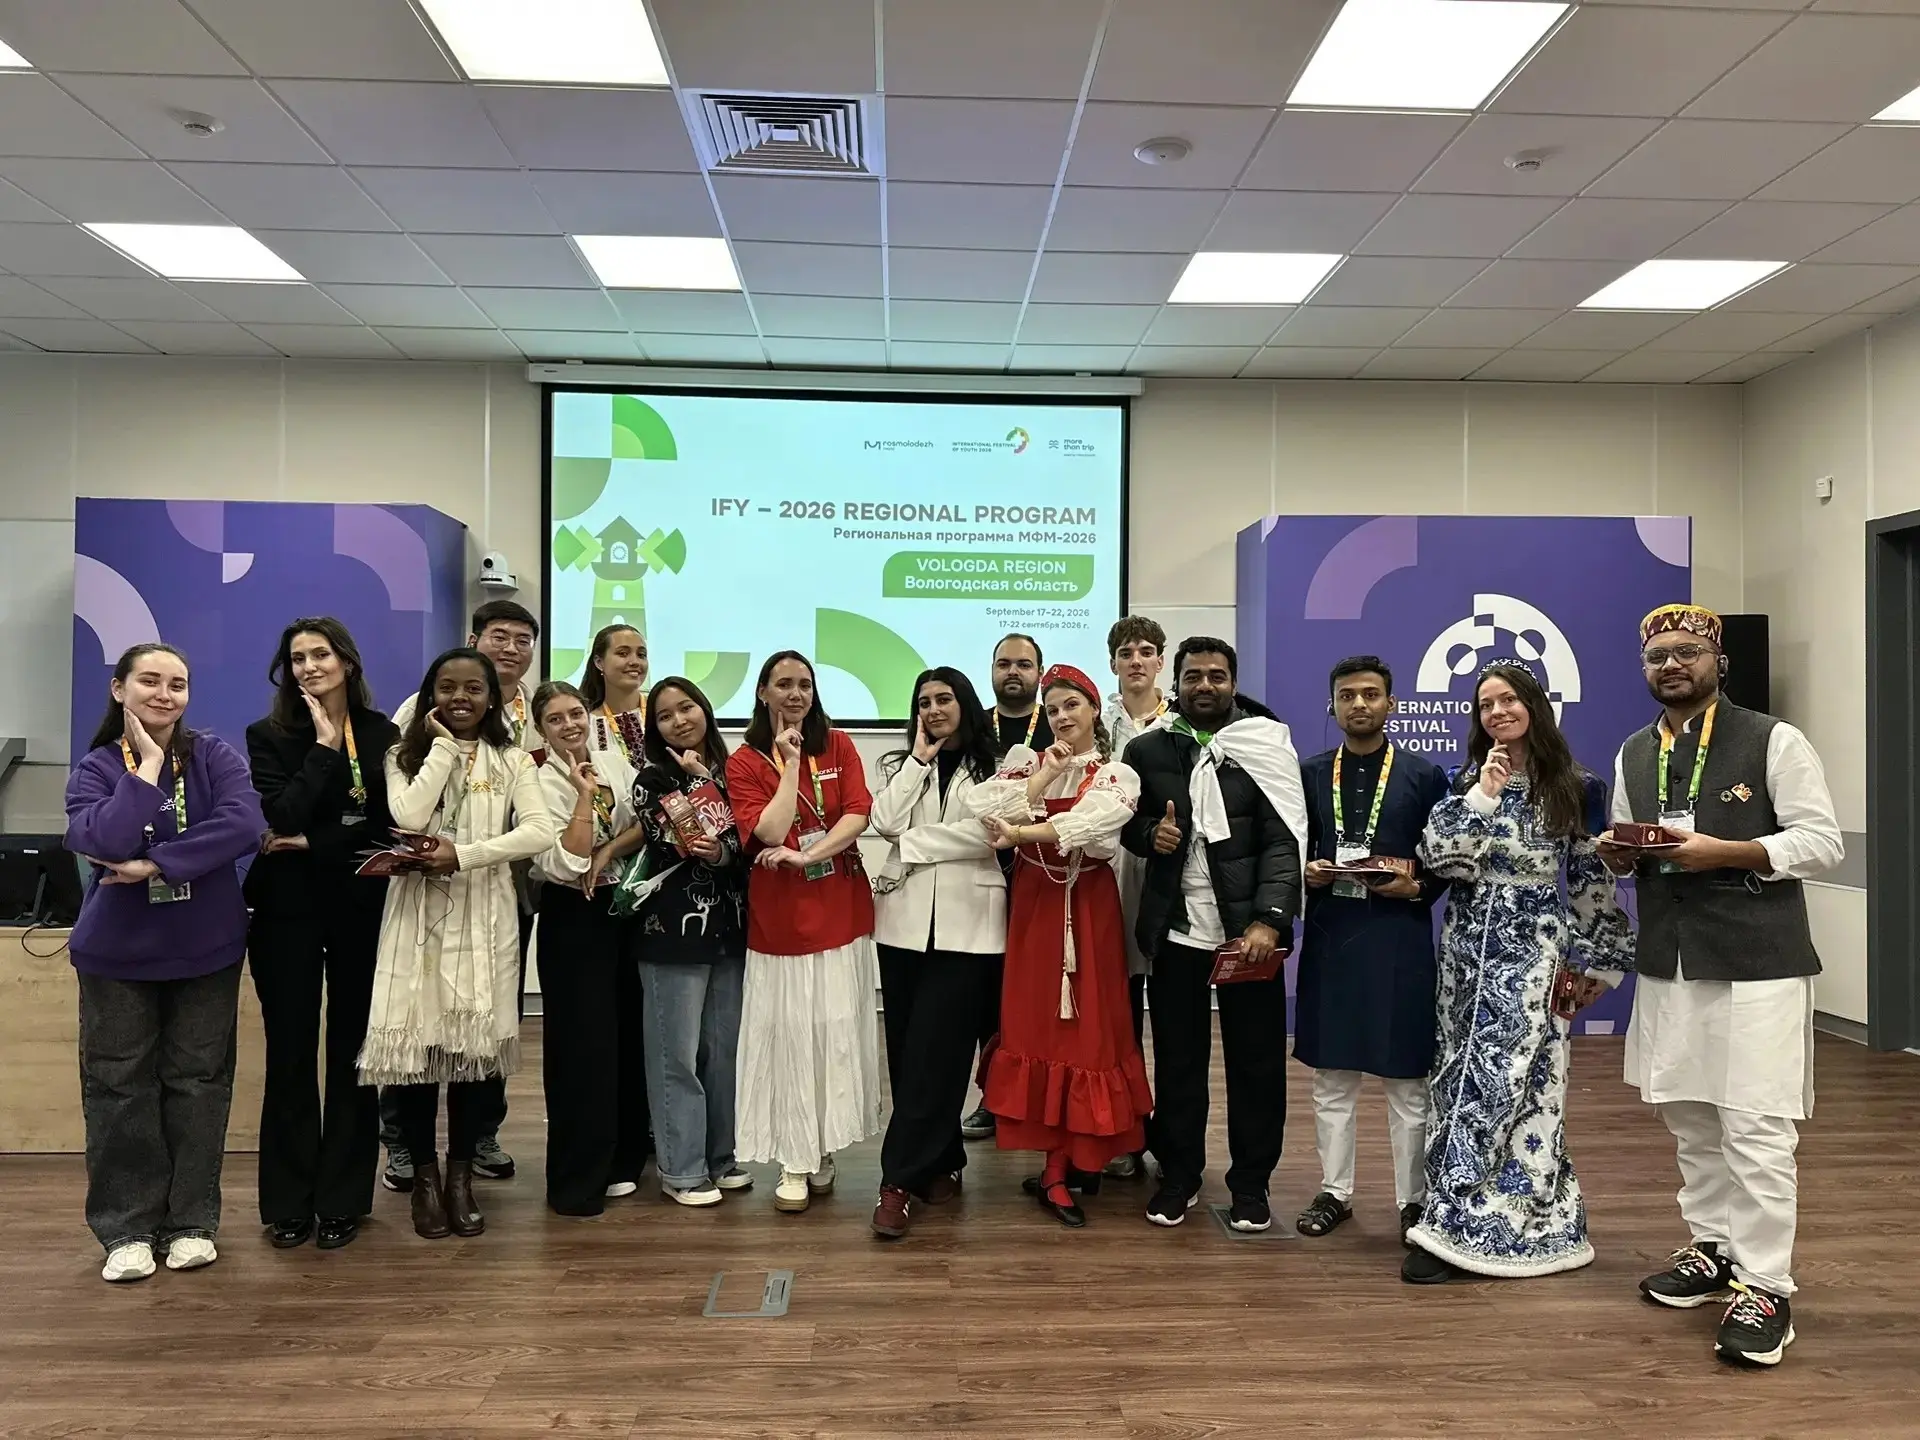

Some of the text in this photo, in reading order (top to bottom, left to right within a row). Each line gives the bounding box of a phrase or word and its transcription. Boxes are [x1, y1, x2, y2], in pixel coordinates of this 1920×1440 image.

[883, 440, 934, 448] rosmolodezh
[711, 498, 750, 516] IFY
[779, 501, 836, 519] 2026
[844, 503, 967, 522] REGIONAL
[975, 506, 1096, 525] PROGRAM
[834, 528, 1096, 544] Региональная программа МФМ-2026
[917, 559, 1066, 574] VOLOGDA REGION
[905, 576, 1078, 592] Вологодская область
[986, 607, 1035, 618] September
[1067, 609, 1090, 617] 2026
[1021, 622, 1060, 630] сентября
[1398, 701, 1472, 714] ERNATIO
[1383, 720, 1450, 733] ESTIVAL
[1397, 739, 1457, 752] YOUTH
